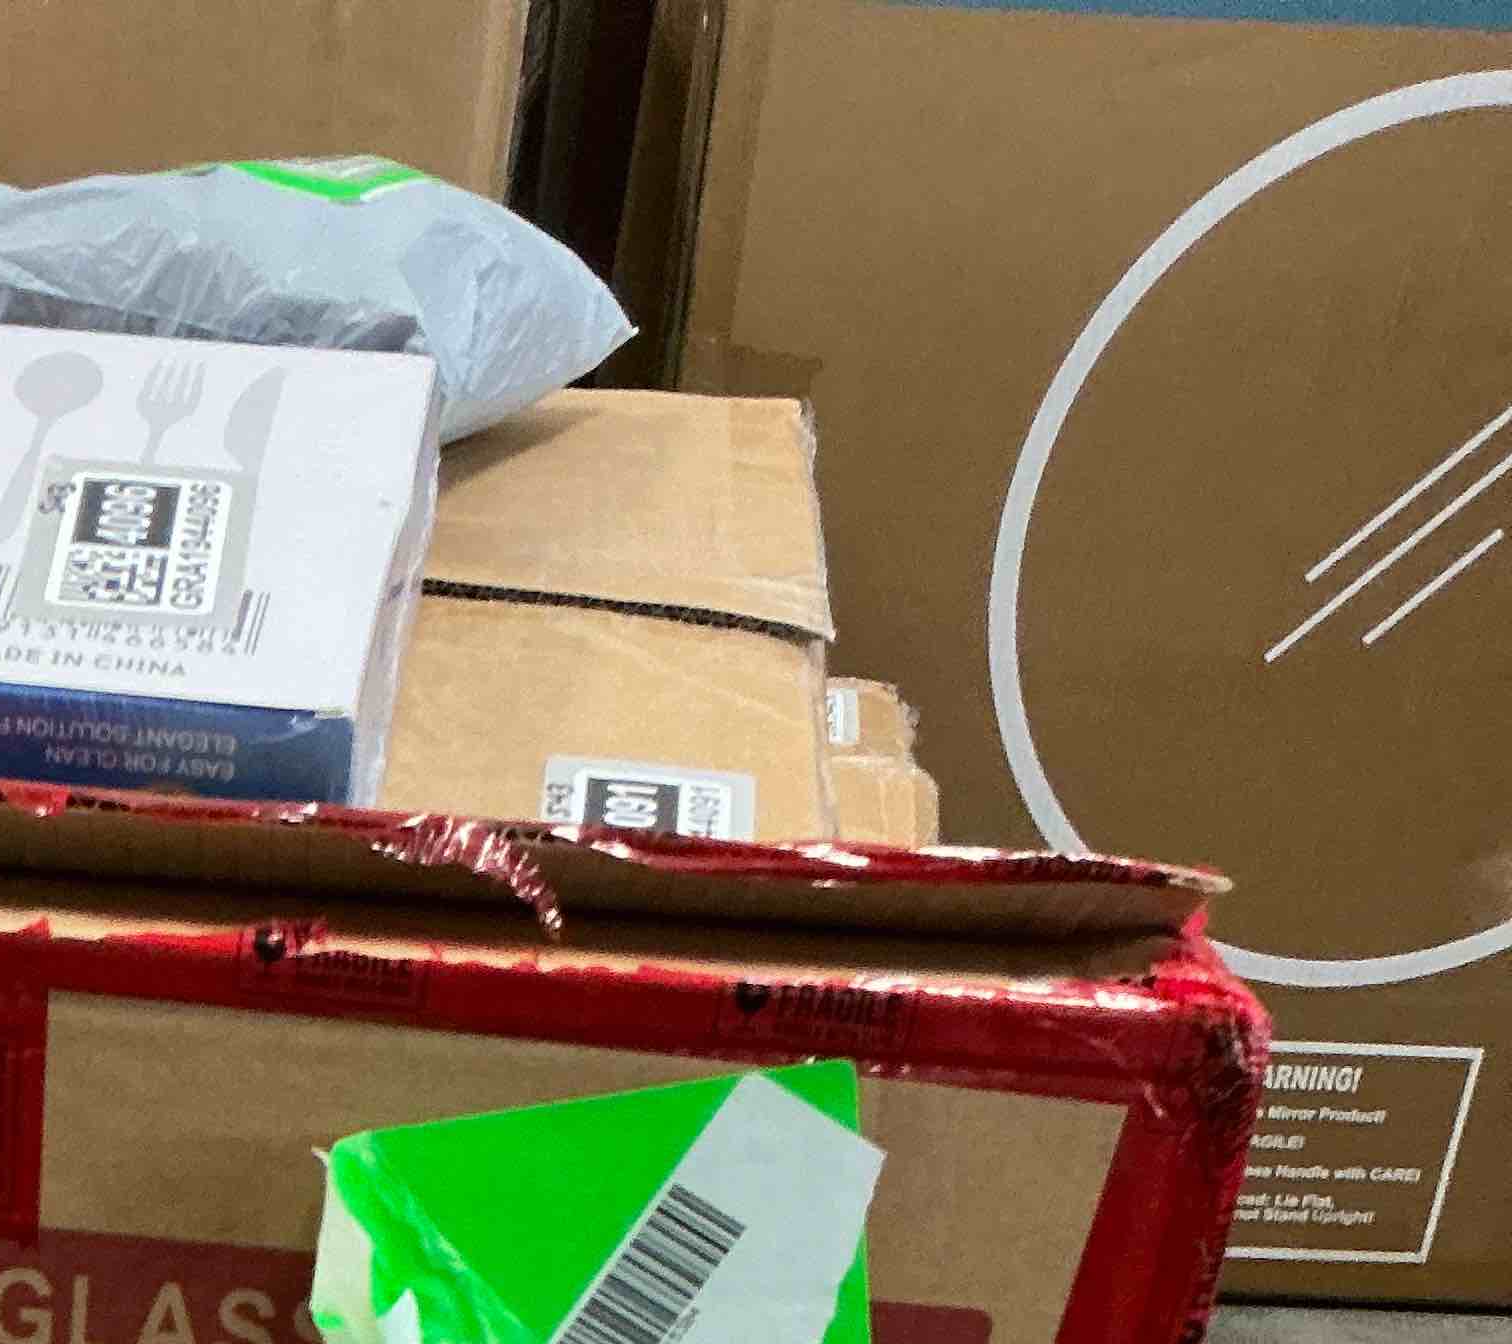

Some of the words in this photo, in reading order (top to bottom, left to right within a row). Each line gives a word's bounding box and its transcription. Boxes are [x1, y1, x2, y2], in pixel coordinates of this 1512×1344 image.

[97, 484, 159, 545] 4096
[51, 650, 84, 668] IN
[94, 654, 188, 678] CHINA
[14, 716, 130, 743] SOLUTION
[133, 727, 237, 755] ELEGANT
[122, 755, 171, 774] FOR
